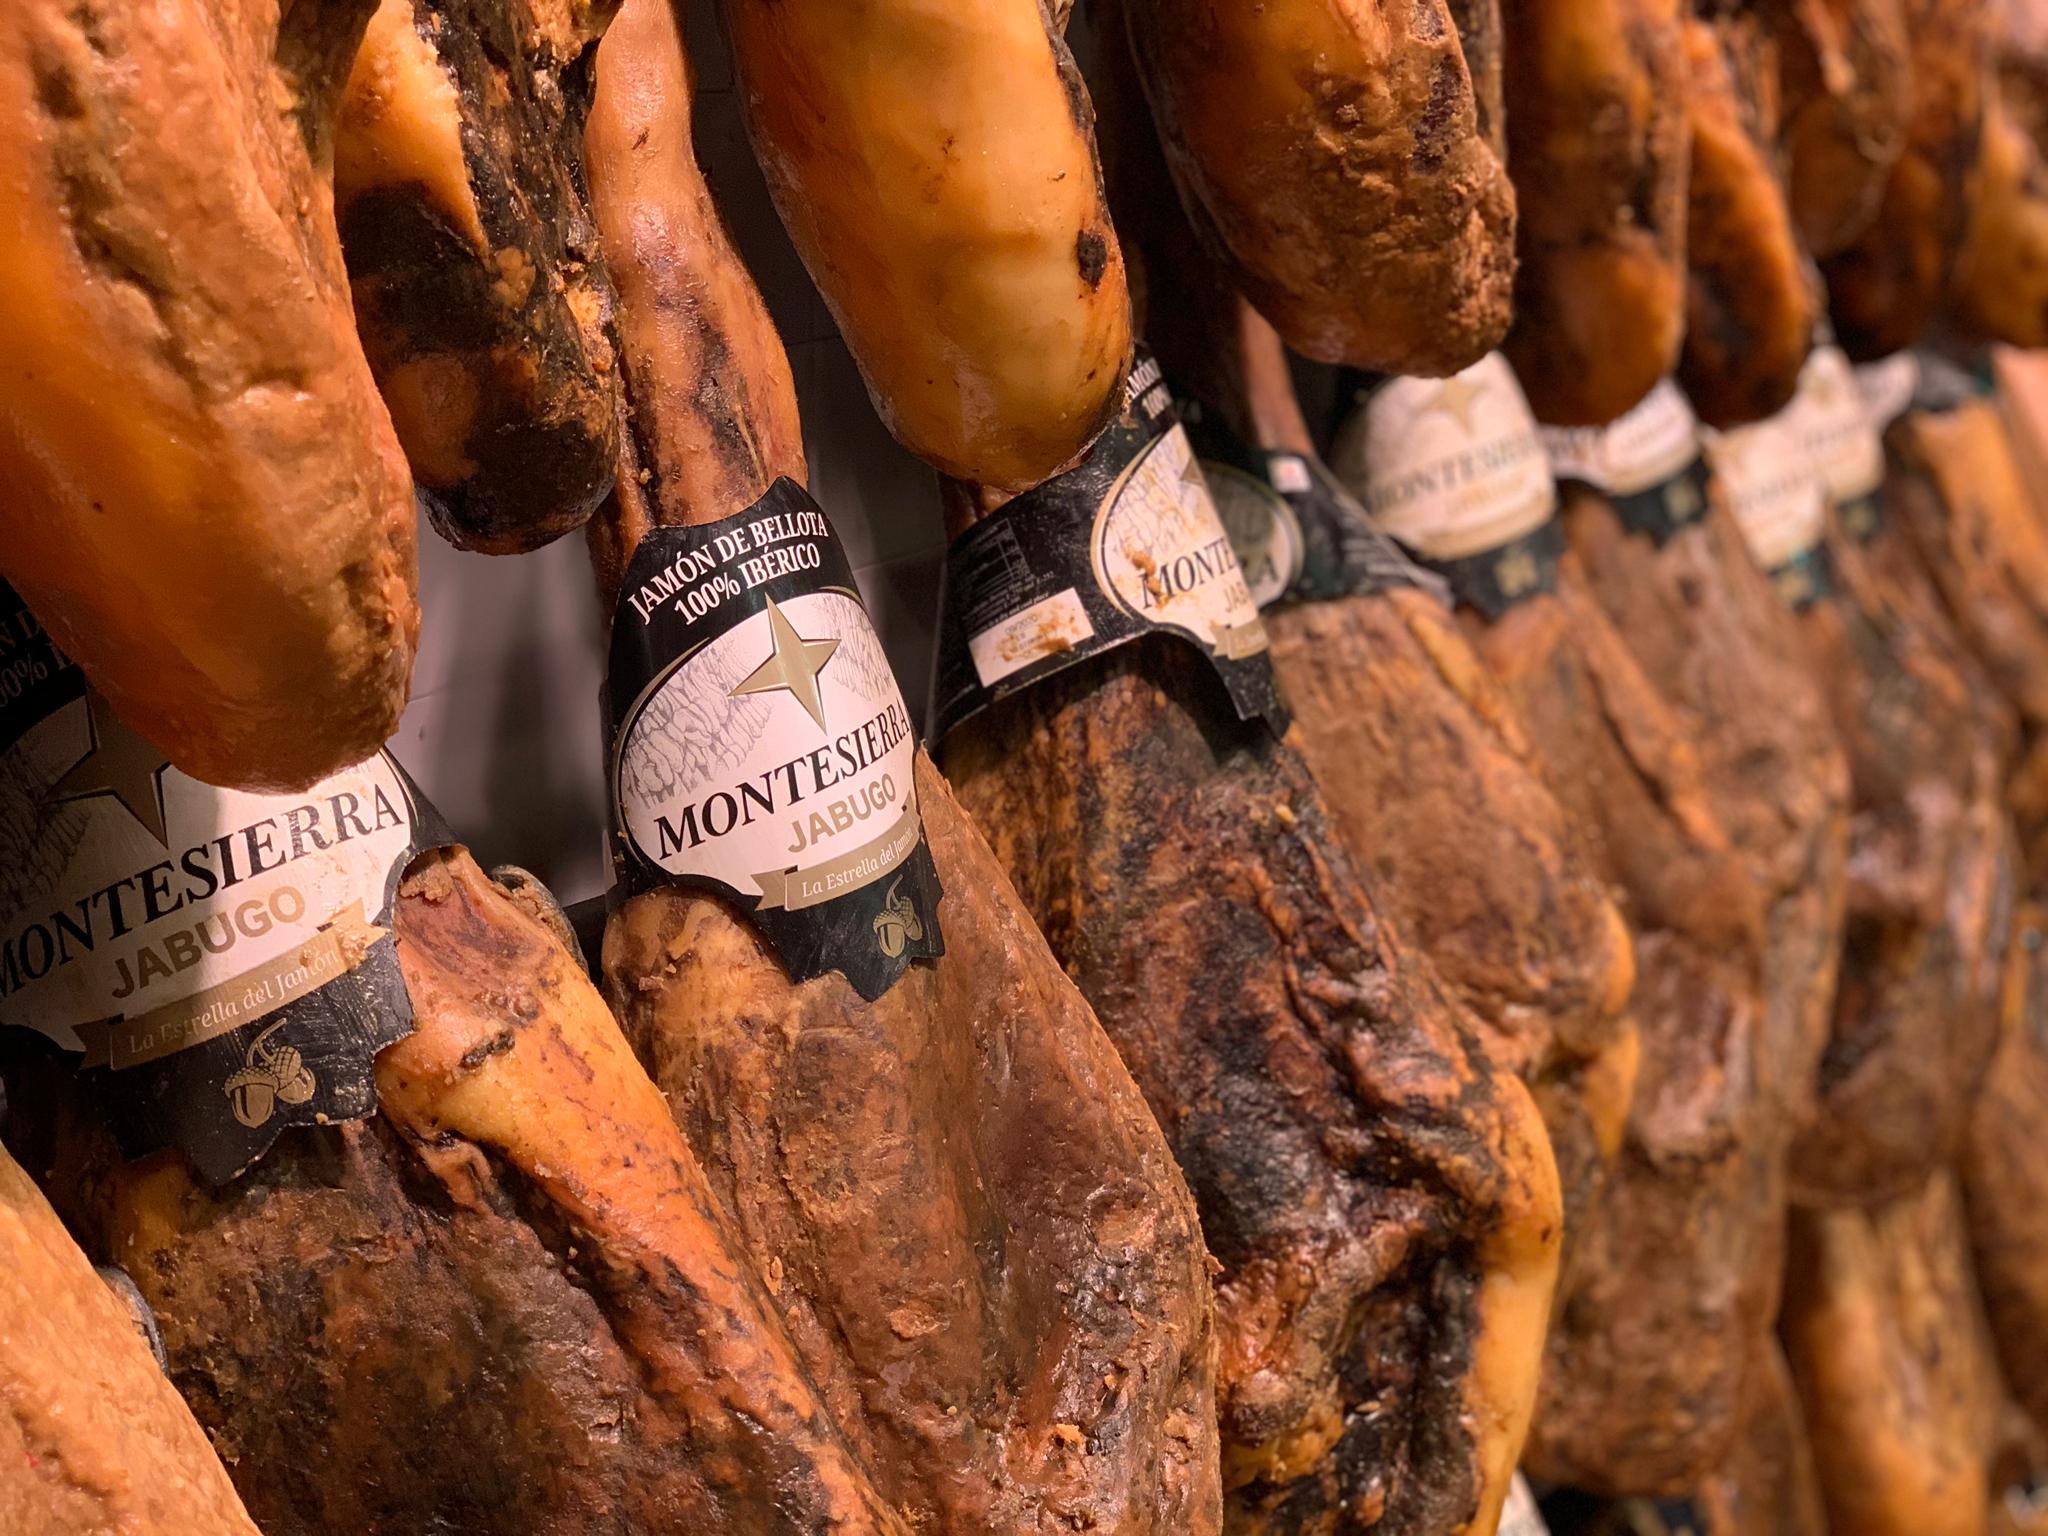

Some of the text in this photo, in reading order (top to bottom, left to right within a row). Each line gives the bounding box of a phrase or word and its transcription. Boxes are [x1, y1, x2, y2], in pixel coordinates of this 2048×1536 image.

[628, 511, 829, 625] JAMÓN DE BELLOTA
[674, 542, 821, 625] 100% IBÉRICO
[653, 696, 910, 861] MONTESIERRA
[787, 772, 896, 854] JABUGO
[802, 881, 823, 899] La
[827, 855, 881, 891] Estrella
[880, 848, 895, 867] del
[112, 885, 306, 999] JABUGO
[130, 1034, 154, 1054] La
[161, 1001, 240, 1043] Estrella
[243, 981, 275, 1010] del
